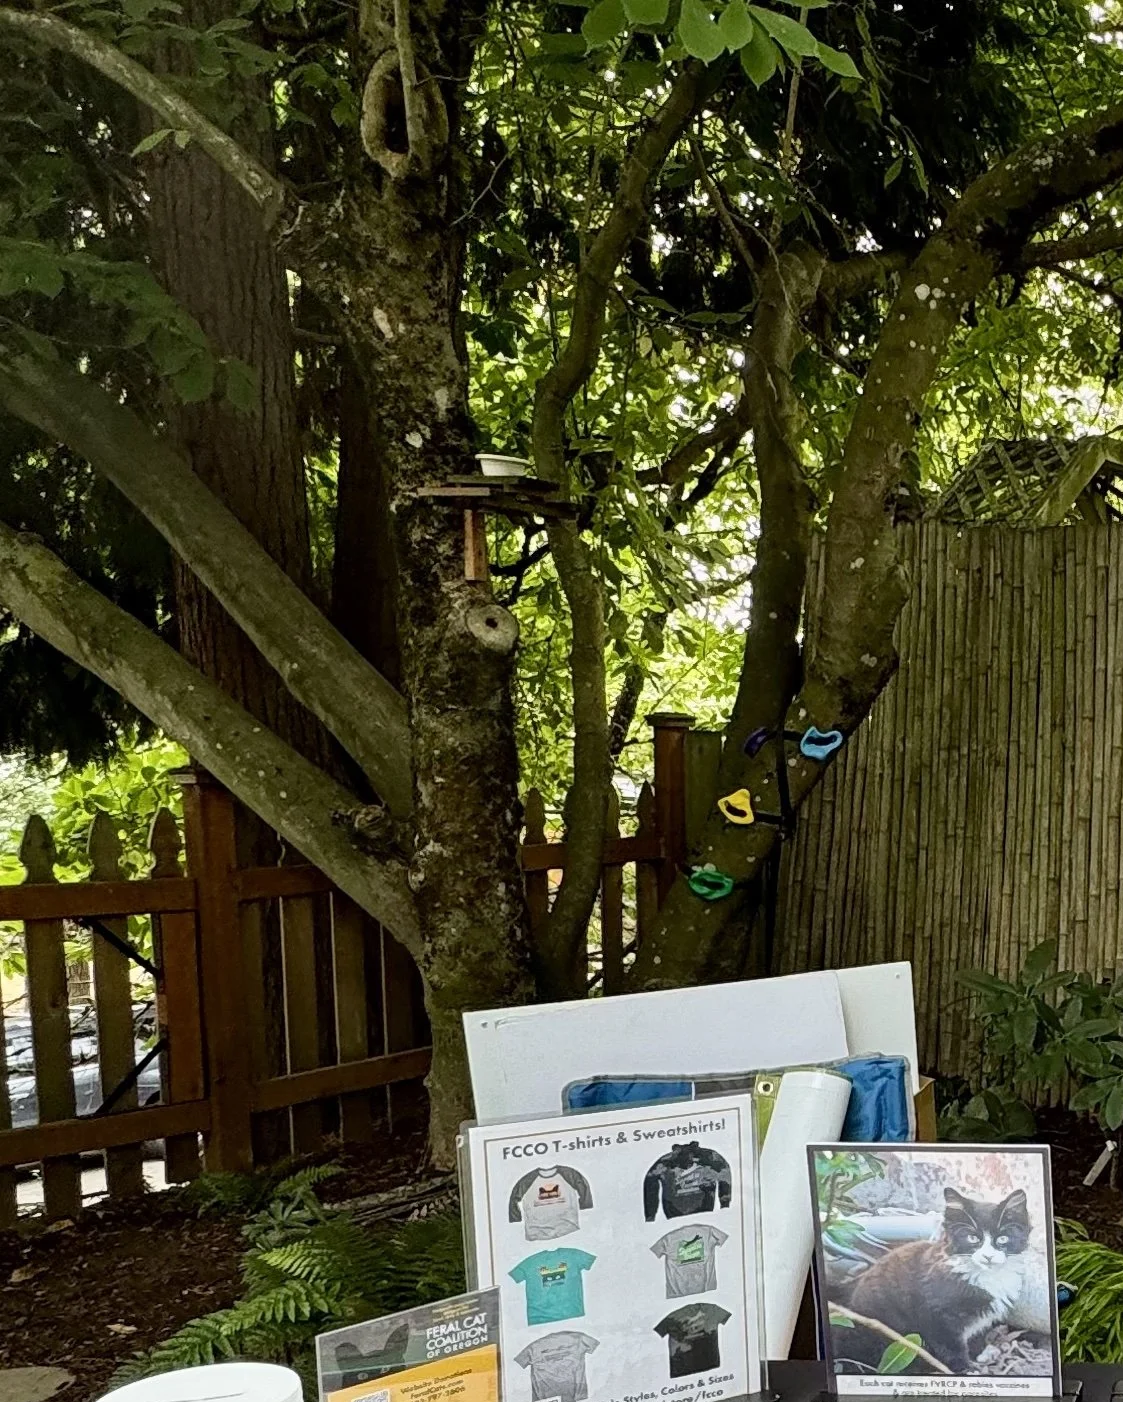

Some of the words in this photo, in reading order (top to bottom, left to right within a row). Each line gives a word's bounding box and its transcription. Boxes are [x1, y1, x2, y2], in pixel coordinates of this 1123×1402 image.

[502, 1142, 549, 1160] FCCO
[552, 1135, 611, 1153] T-shirts
[616, 1131, 628, 1144] &
[633, 1118, 726, 1142] Sweatshirts!
[426, 1320, 462, 1340] FERAL
[463, 1312, 488, 1329] CAT
[426, 1324, 488, 1351] COALITION
[444, 1334, 489, 1355] OREGON
[661, 1384, 695, 1397] Colors
[708, 1373, 735, 1386] Sizes
